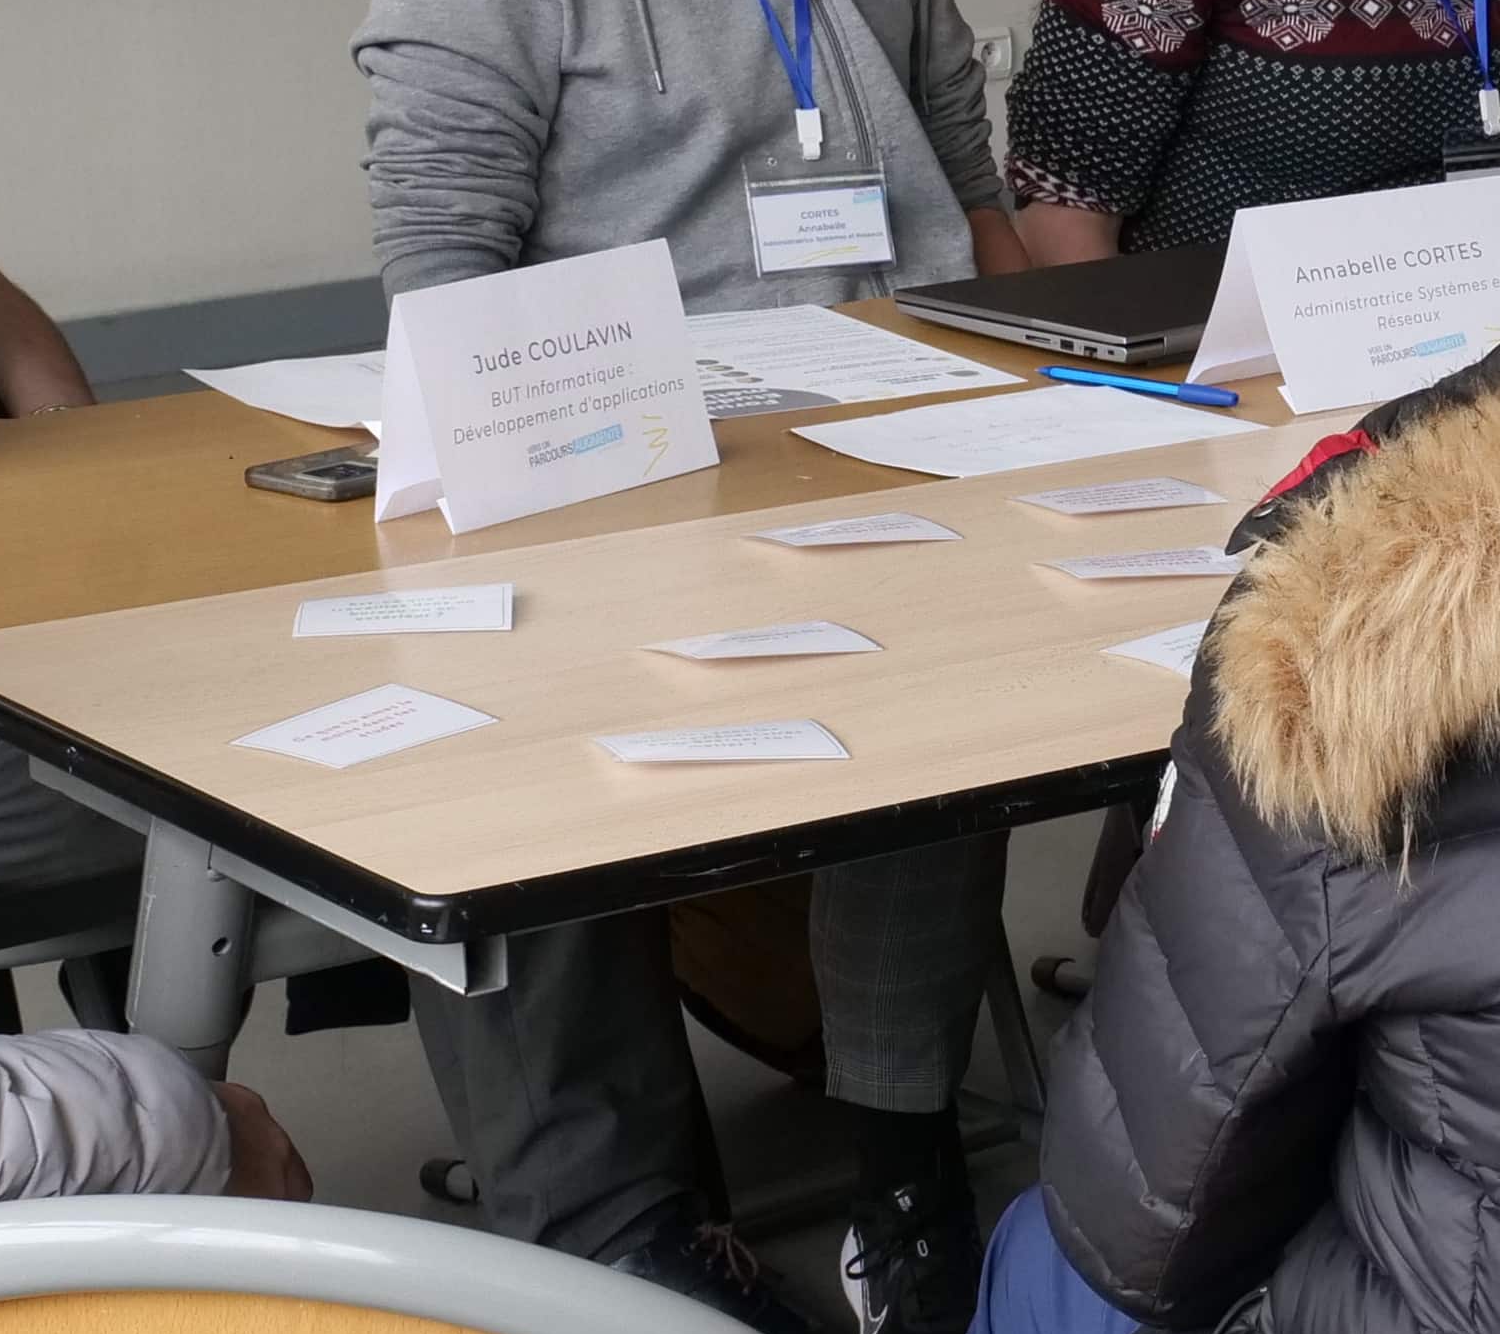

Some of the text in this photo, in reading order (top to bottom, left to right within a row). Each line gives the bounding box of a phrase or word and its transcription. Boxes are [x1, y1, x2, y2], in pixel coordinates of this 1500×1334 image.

[798, 221, 846, 233] Annabelle
[800, 208, 840, 220] CORTES
[1296, 241, 1482, 284] Annabelle CORTES
[1294, 290, 1413, 319] Administratrice
[1418, 280, 1488, 302] Systèmes
[1377, 309, 1441, 331] Réseaux
[472, 321, 633, 374] Jude COULAVIN
[491, 386, 522, 408] BUT
[526, 363, 626, 400] Informatique
[453, 403, 575, 445] Développement
[579, 377, 685, 415] d'applications
[528, 442, 574, 468] PARCOURS
